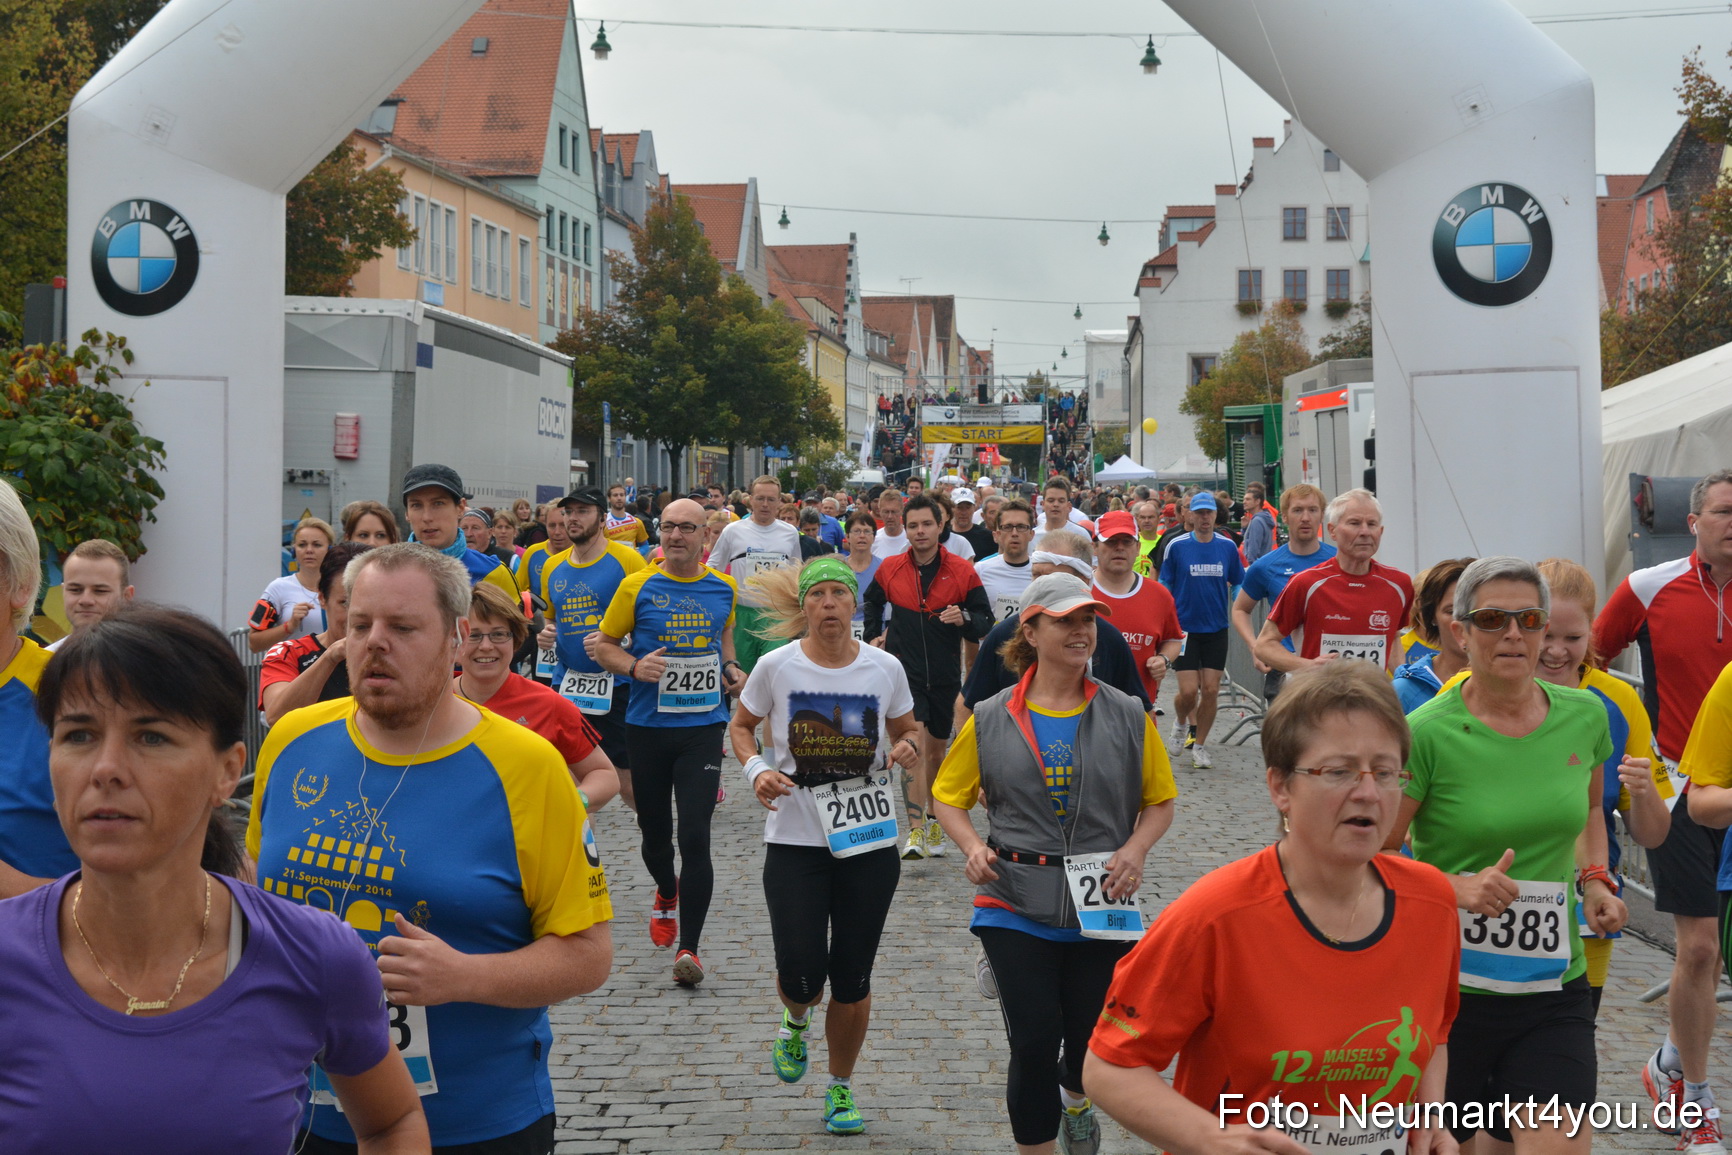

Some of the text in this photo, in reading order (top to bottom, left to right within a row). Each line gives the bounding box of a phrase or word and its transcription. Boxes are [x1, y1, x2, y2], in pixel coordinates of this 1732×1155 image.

[1441, 185, 1544, 228] BMW
[97, 200, 191, 241] BMW
[538, 398, 567, 439] BOCK
[961, 428, 1004, 441] START
[1189, 564, 1224, 573] HUBER
[1322, 639, 1377, 648] PARTL Neumarkt
[684, 661, 712, 669] Neumarkt
[565, 677, 608, 696] 2620
[666, 669, 716, 692] 2426
[675, 696, 706, 706] Norbert
[793, 722, 814, 734] 11.
[801, 735, 870, 747] AMBERGER
[793, 746, 843, 757] RUNNING
[308, 774, 318, 784] 15
[298, 783, 318, 797] Jahre
[815, 780, 877, 801] PARTL Neumarkt
[827, 789, 891, 830] 2406
[848, 827, 885, 845] Claudia
[1066, 863, 1098, 874] PARTL
[282, 866, 393, 898] 21.September 2014
[1513, 893, 1555, 905] eumarkt
[1107, 914, 1127, 931] Birgit
[1463, 908, 1559, 953] 3383
[1269, 1047, 1388, 1084] 12. MAISEL'S
[1316, 1064, 1390, 1082] FunRun
[1325, 1127, 1390, 1148] Neumarkt
